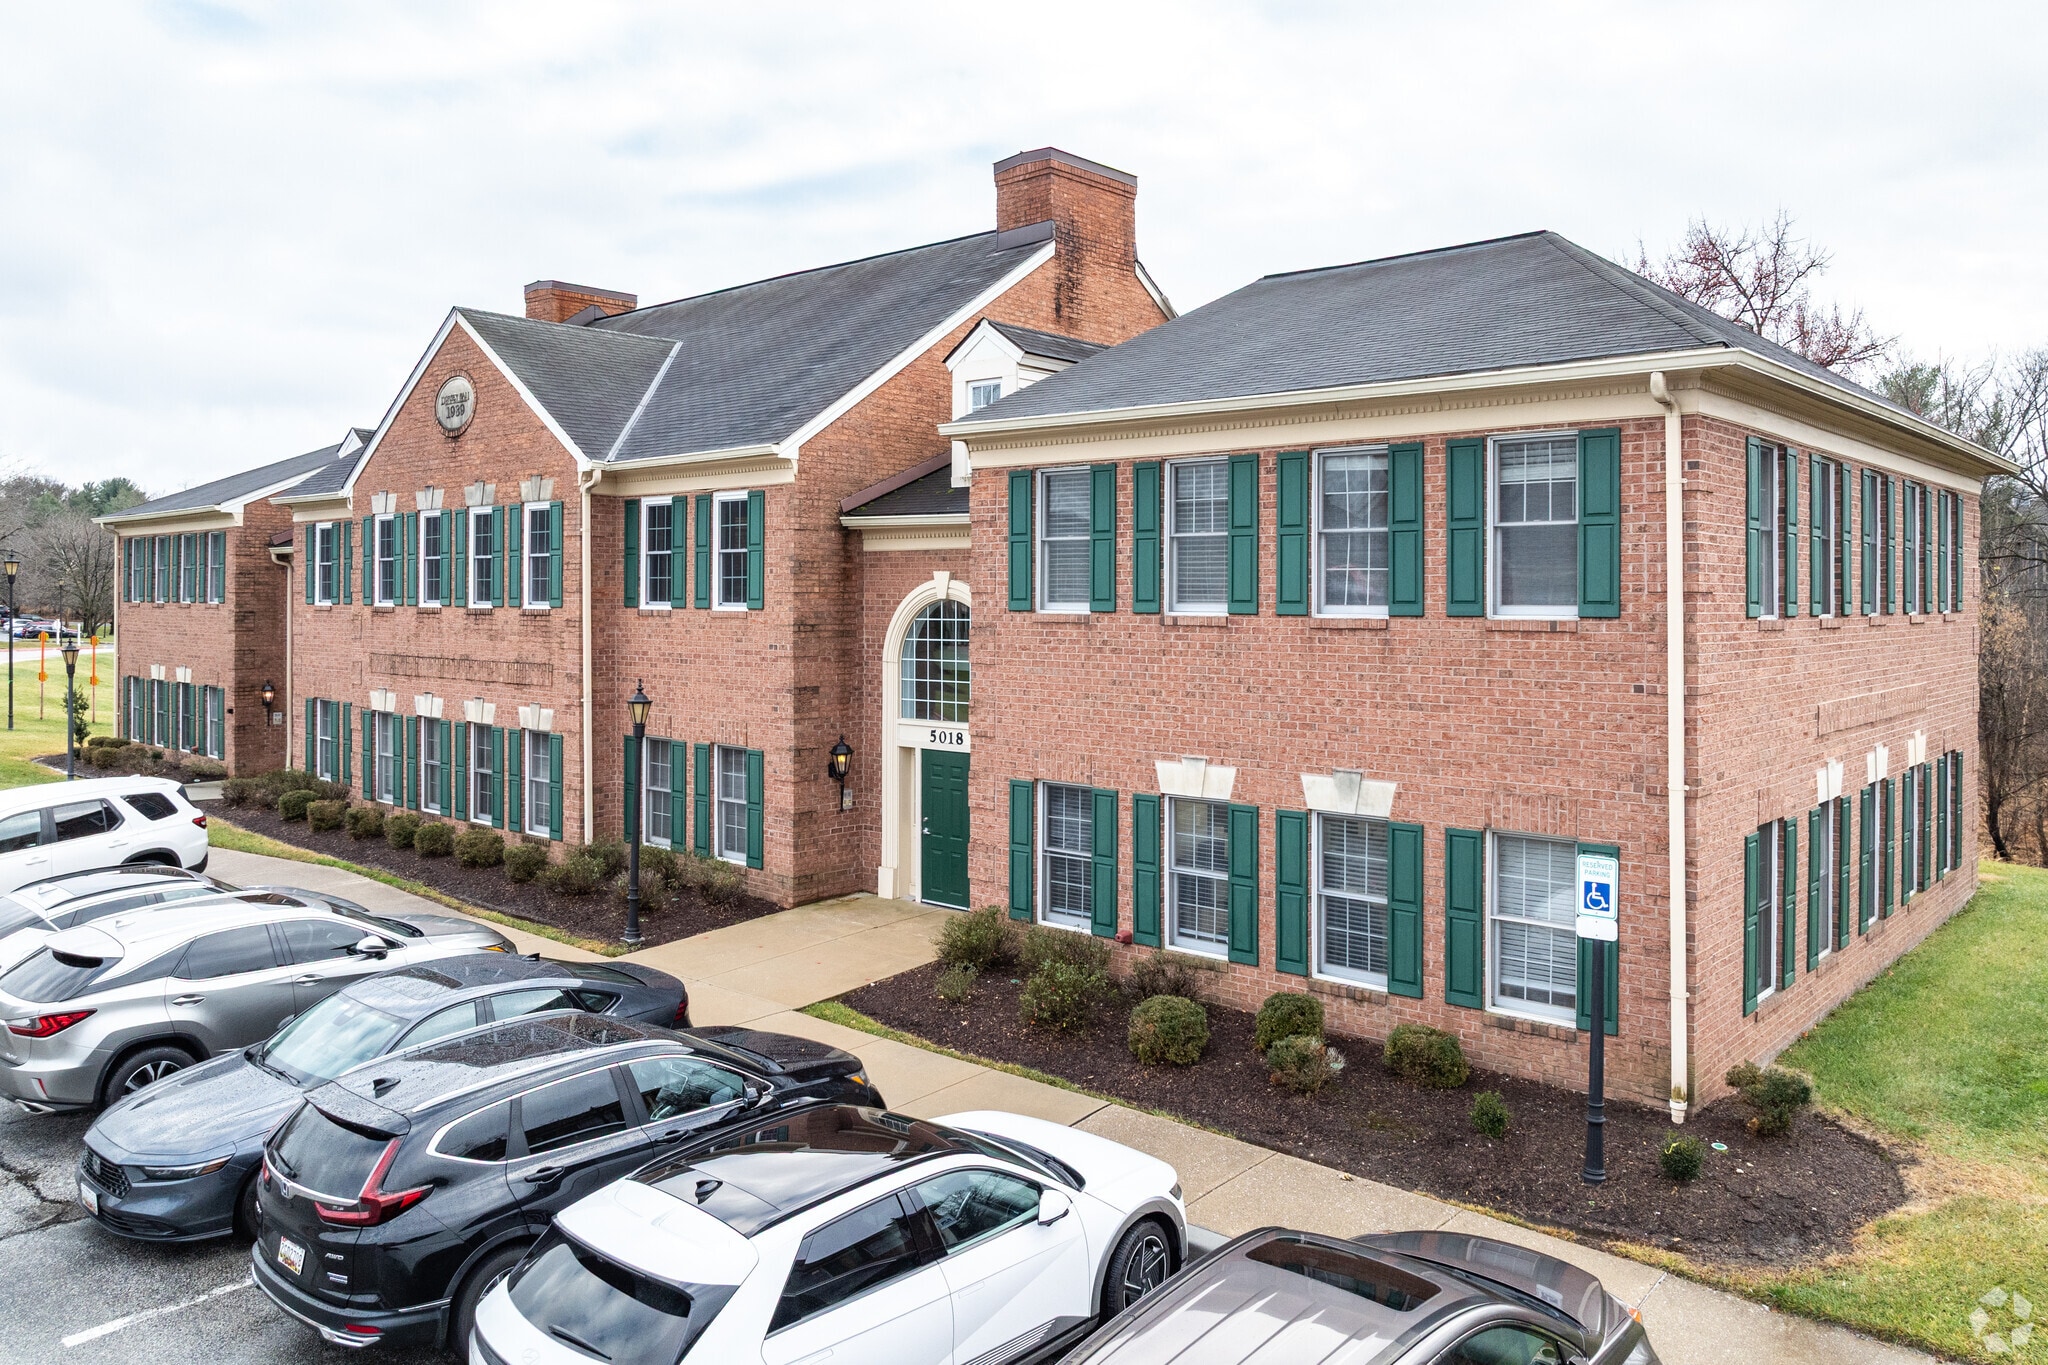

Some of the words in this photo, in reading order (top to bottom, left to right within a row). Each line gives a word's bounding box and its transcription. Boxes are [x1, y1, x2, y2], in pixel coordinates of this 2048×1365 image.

[930, 729, 964, 745] 5018
[1582, 861, 1613, 871] RESERVED
[1584, 869, 1611, 878] PARKING
[325, 1252, 344, 1261] AWD
